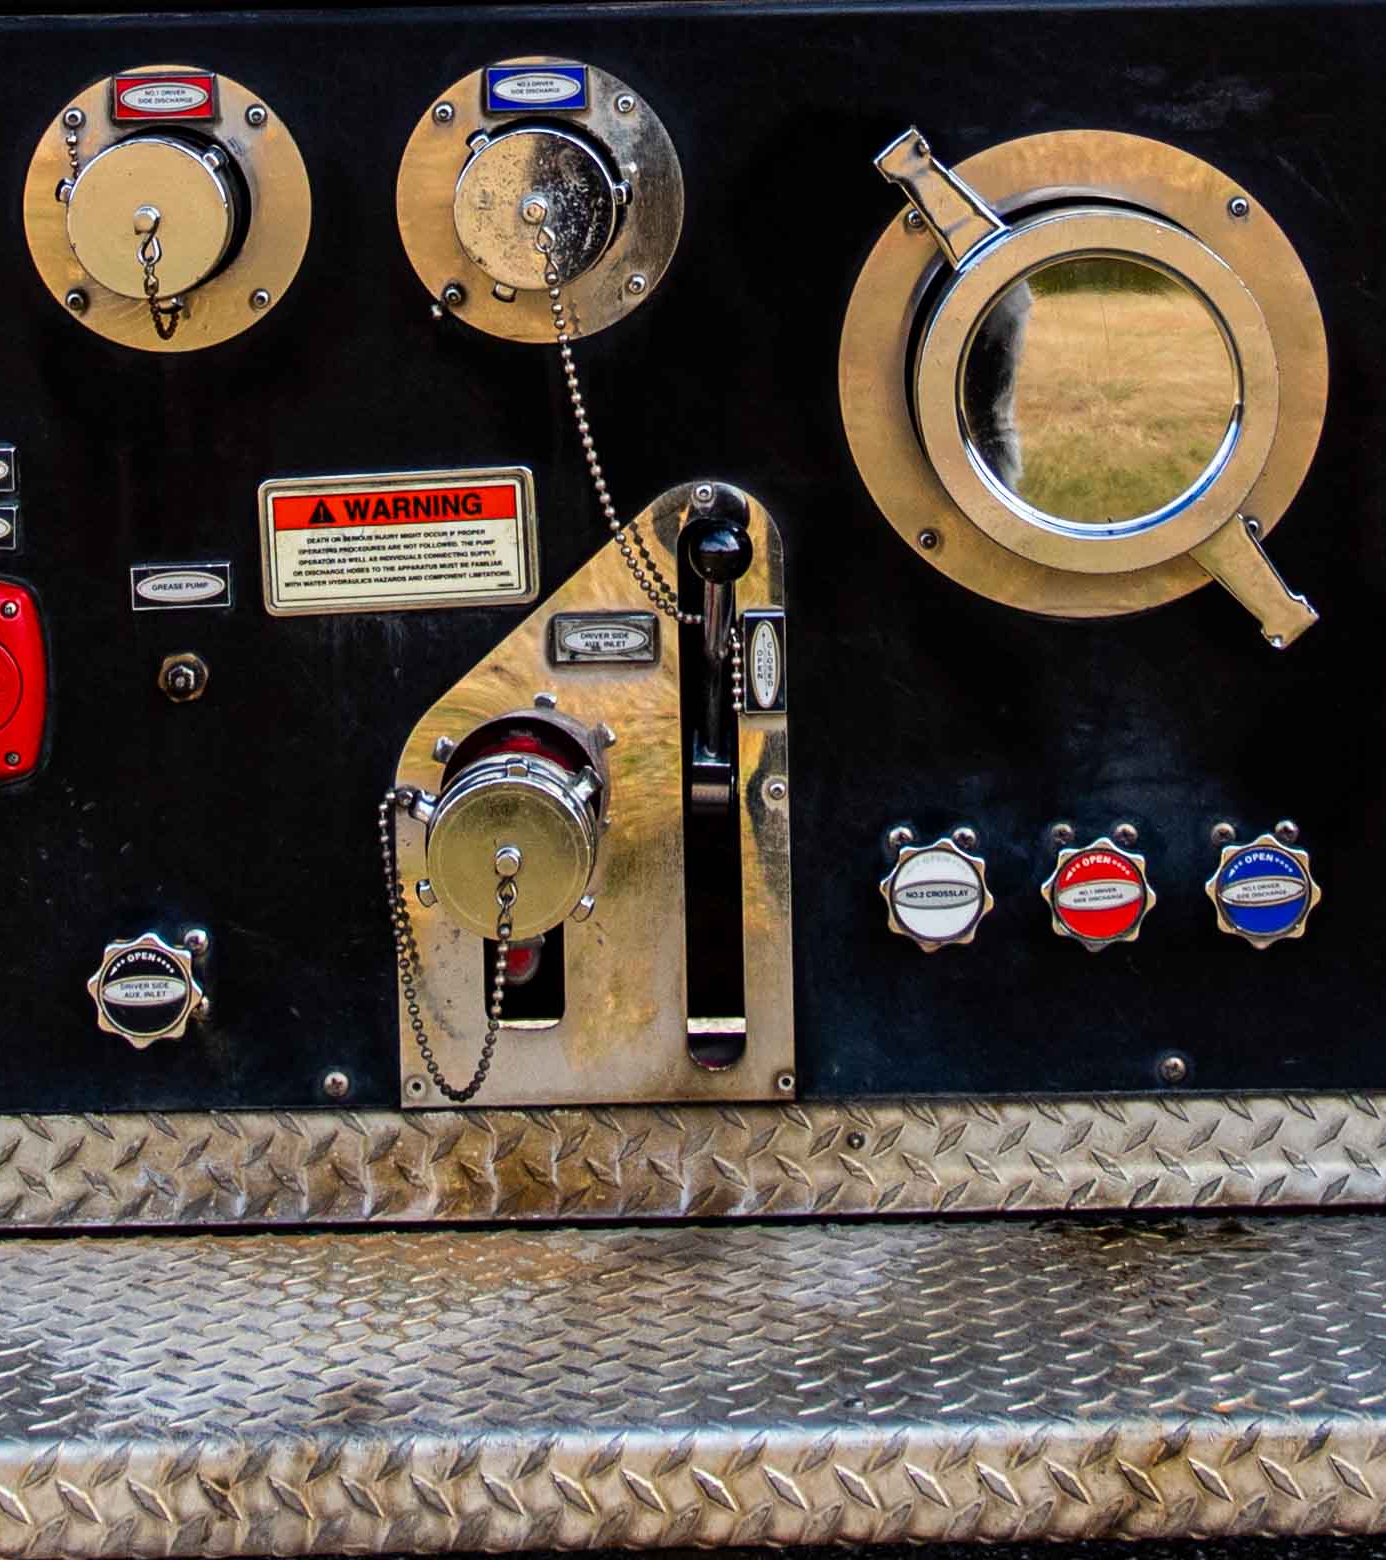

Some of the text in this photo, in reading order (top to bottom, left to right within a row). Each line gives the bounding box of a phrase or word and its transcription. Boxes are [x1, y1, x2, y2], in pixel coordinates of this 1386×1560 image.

[344, 493, 483, 521] WARNING
[152, 583, 183, 591] GREASE
[1082, 856, 1111, 867] OPEN
[1245, 853, 1274, 864] OPEN
[926, 890, 969, 898] CROSSLAY
[127, 952, 156, 962] OPEN
[120, 982, 149, 990] DRIVER
